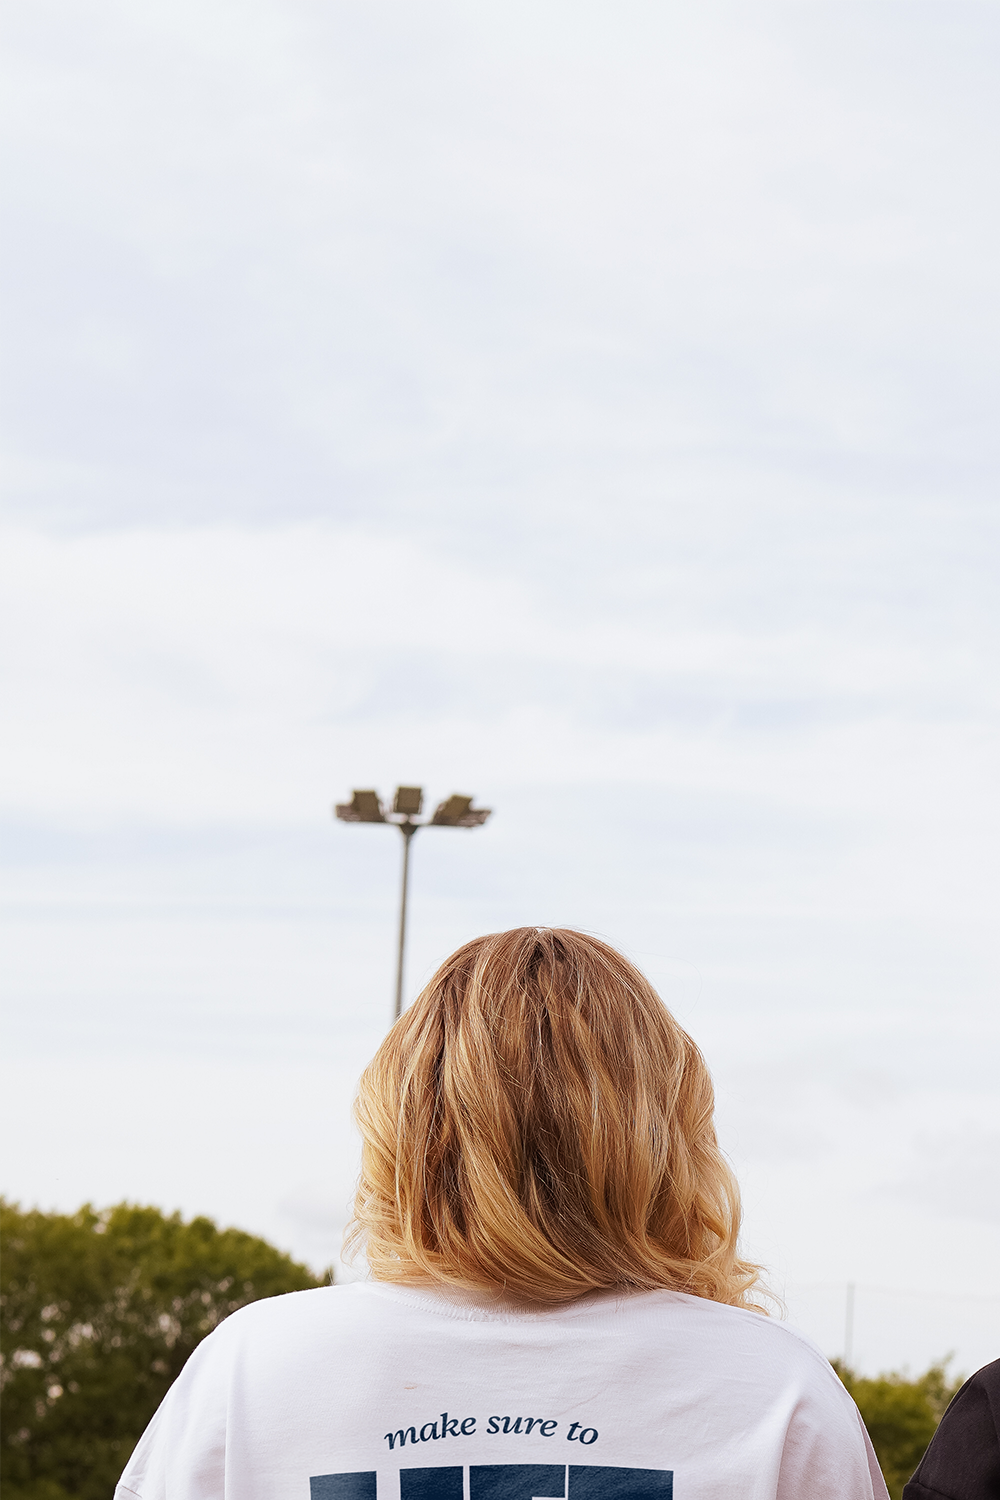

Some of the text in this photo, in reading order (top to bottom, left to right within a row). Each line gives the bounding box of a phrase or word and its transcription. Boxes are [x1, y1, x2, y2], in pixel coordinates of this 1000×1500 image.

[384, 1412, 599, 1450] make sure to
